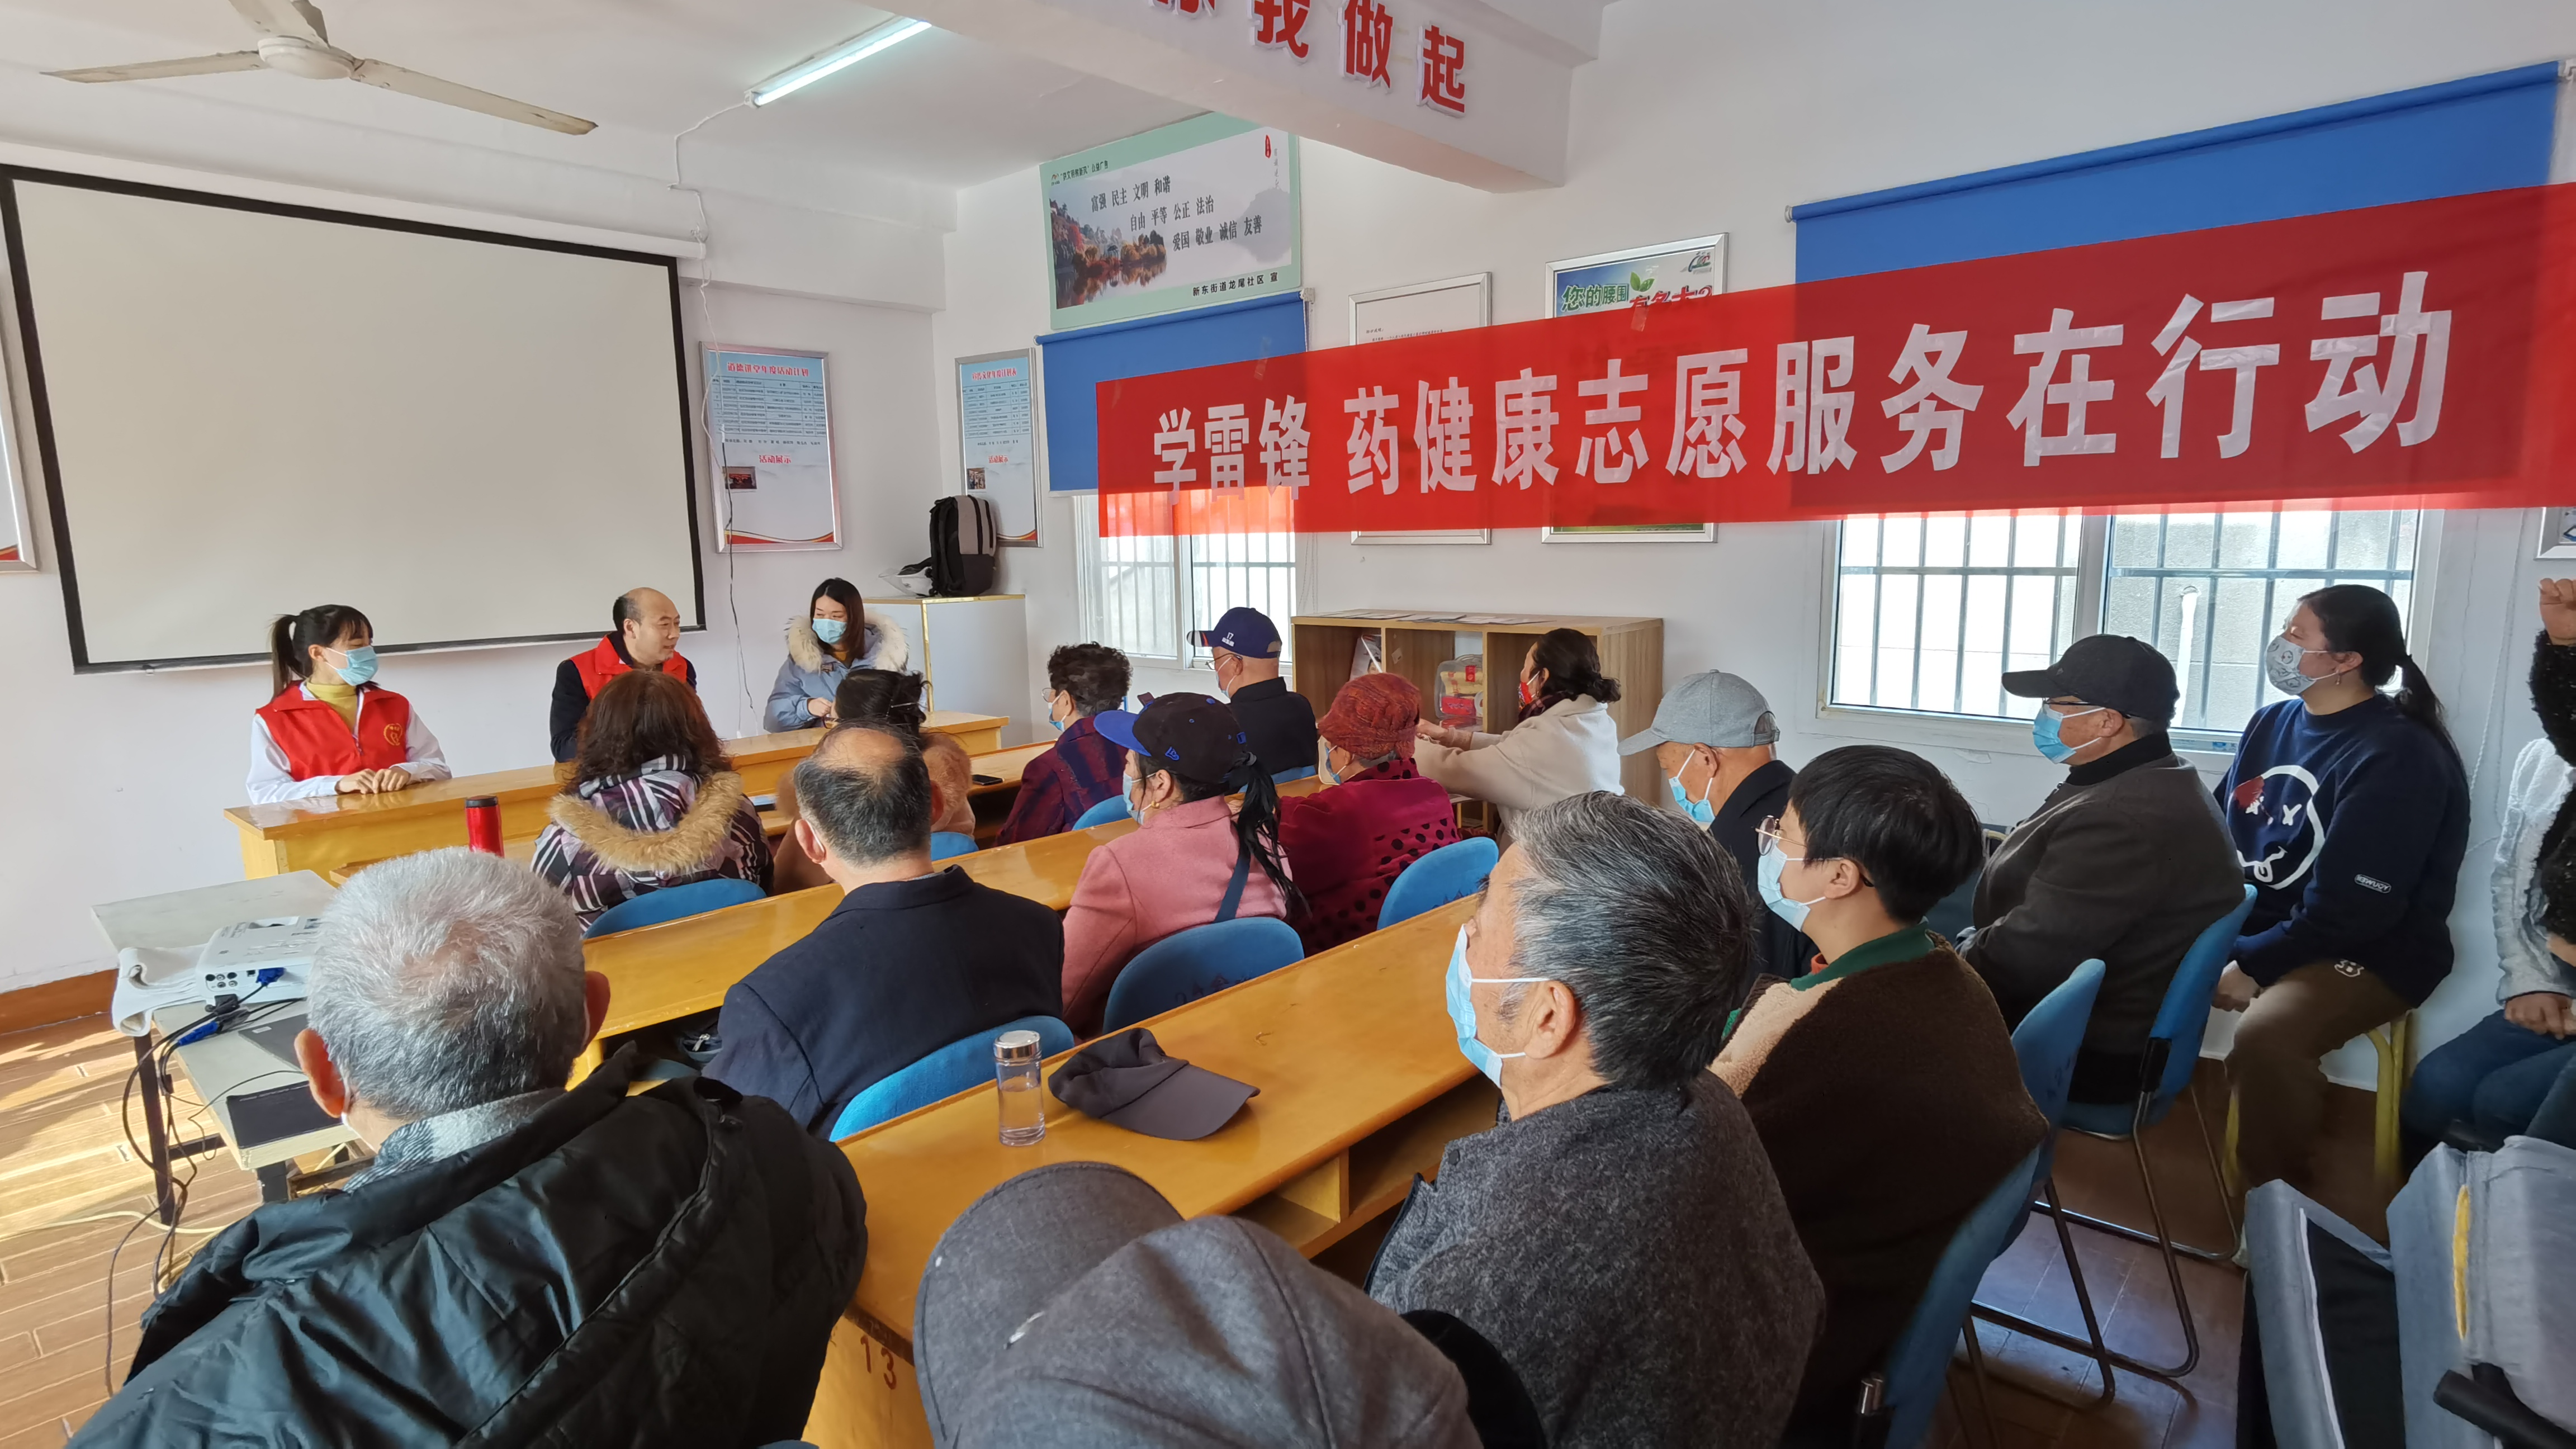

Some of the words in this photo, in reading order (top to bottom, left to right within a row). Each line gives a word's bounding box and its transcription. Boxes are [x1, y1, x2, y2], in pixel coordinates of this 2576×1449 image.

[1149, 0, 1465, 113] 我做起
[1091, 192, 1107, 212] 富强
[1111, 187, 1128, 207] 民主
[1133, 181, 1149, 201] 文明
[1154, 175, 1171, 196] 和谐
[1130, 211, 1145, 231] 自由
[1151, 206, 1167, 226] 平等
[1173, 201, 1191, 221] 公正
[1196, 195, 1214, 215] 法治
[1172, 231, 1190, 252] 爱国
[1195, 226, 1213, 246] 敬业
[1220, 220, 1237, 241] 诚信
[1244, 215, 1262, 236] 友善
[1192, 274, 1264, 297] 新东街道龙尾社区
[1270, 272, 1278, 282] 宣
[1560, 283, 1629, 312] 您的腰围
[1153, 394, 1310, 506] 学雷锋
[1343, 271, 2452, 495] 药健康志愿服务在行动
[860, 1334, 897, 1390] 13
